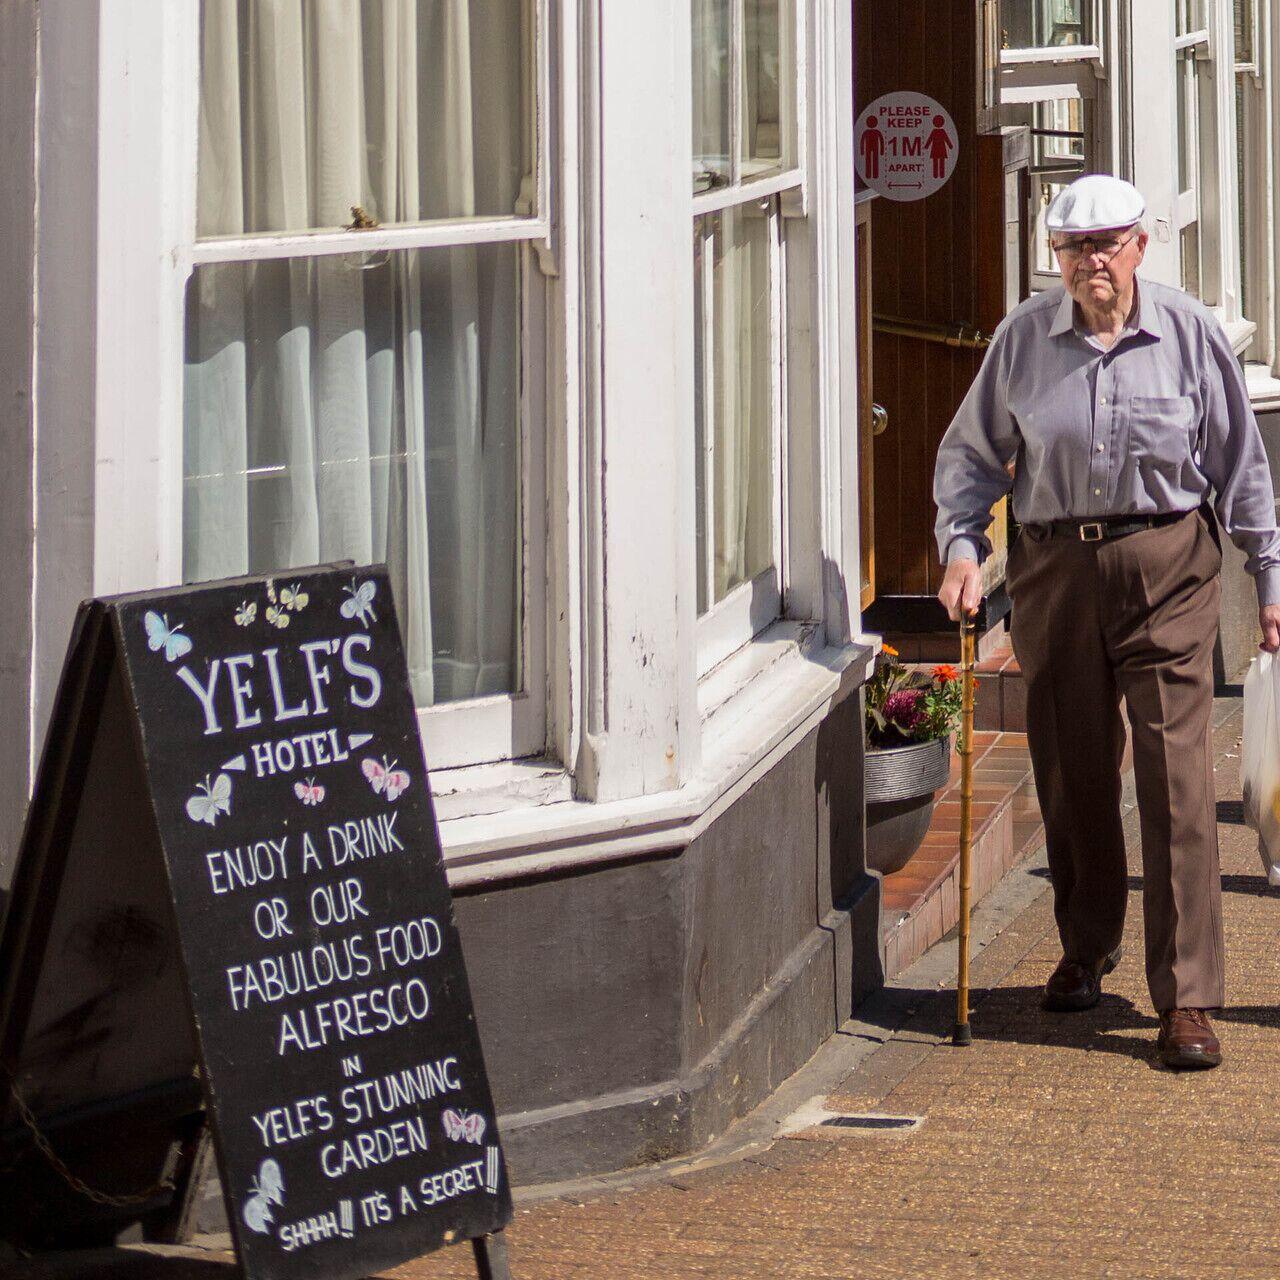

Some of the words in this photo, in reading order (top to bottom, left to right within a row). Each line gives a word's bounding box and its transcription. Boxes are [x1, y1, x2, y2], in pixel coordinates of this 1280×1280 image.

[879, 106, 931, 117] PLEASE
[887, 119, 922, 129] KEEP
[888, 136, 922, 157] 1M
[888, 163, 922, 173] APART
[177, 634, 382, 735] YELF'S
[251, 729, 349, 778] HOTEL
[207, 837, 288, 894] ENJOY
[303, 832, 323, 874] A
[328, 811, 404, 866] DRINK
[255, 898, 293, 939] OR
[311, 878, 369, 926] OUR
[227, 935, 372, 1011] FABULOUS
[376, 917, 442, 971] FOOD
[279, 978, 430, 1056] ALFRESCO
[342, 1055, 363, 1077] IN
[253, 1096, 333, 1148] YELF'S
[341, 1057, 461, 1124] STUNNING
[321, 1117, 428, 1178] GARDEN
[361, 1190, 392, 1228] IT'S
[401, 1186, 418, 1215] A
